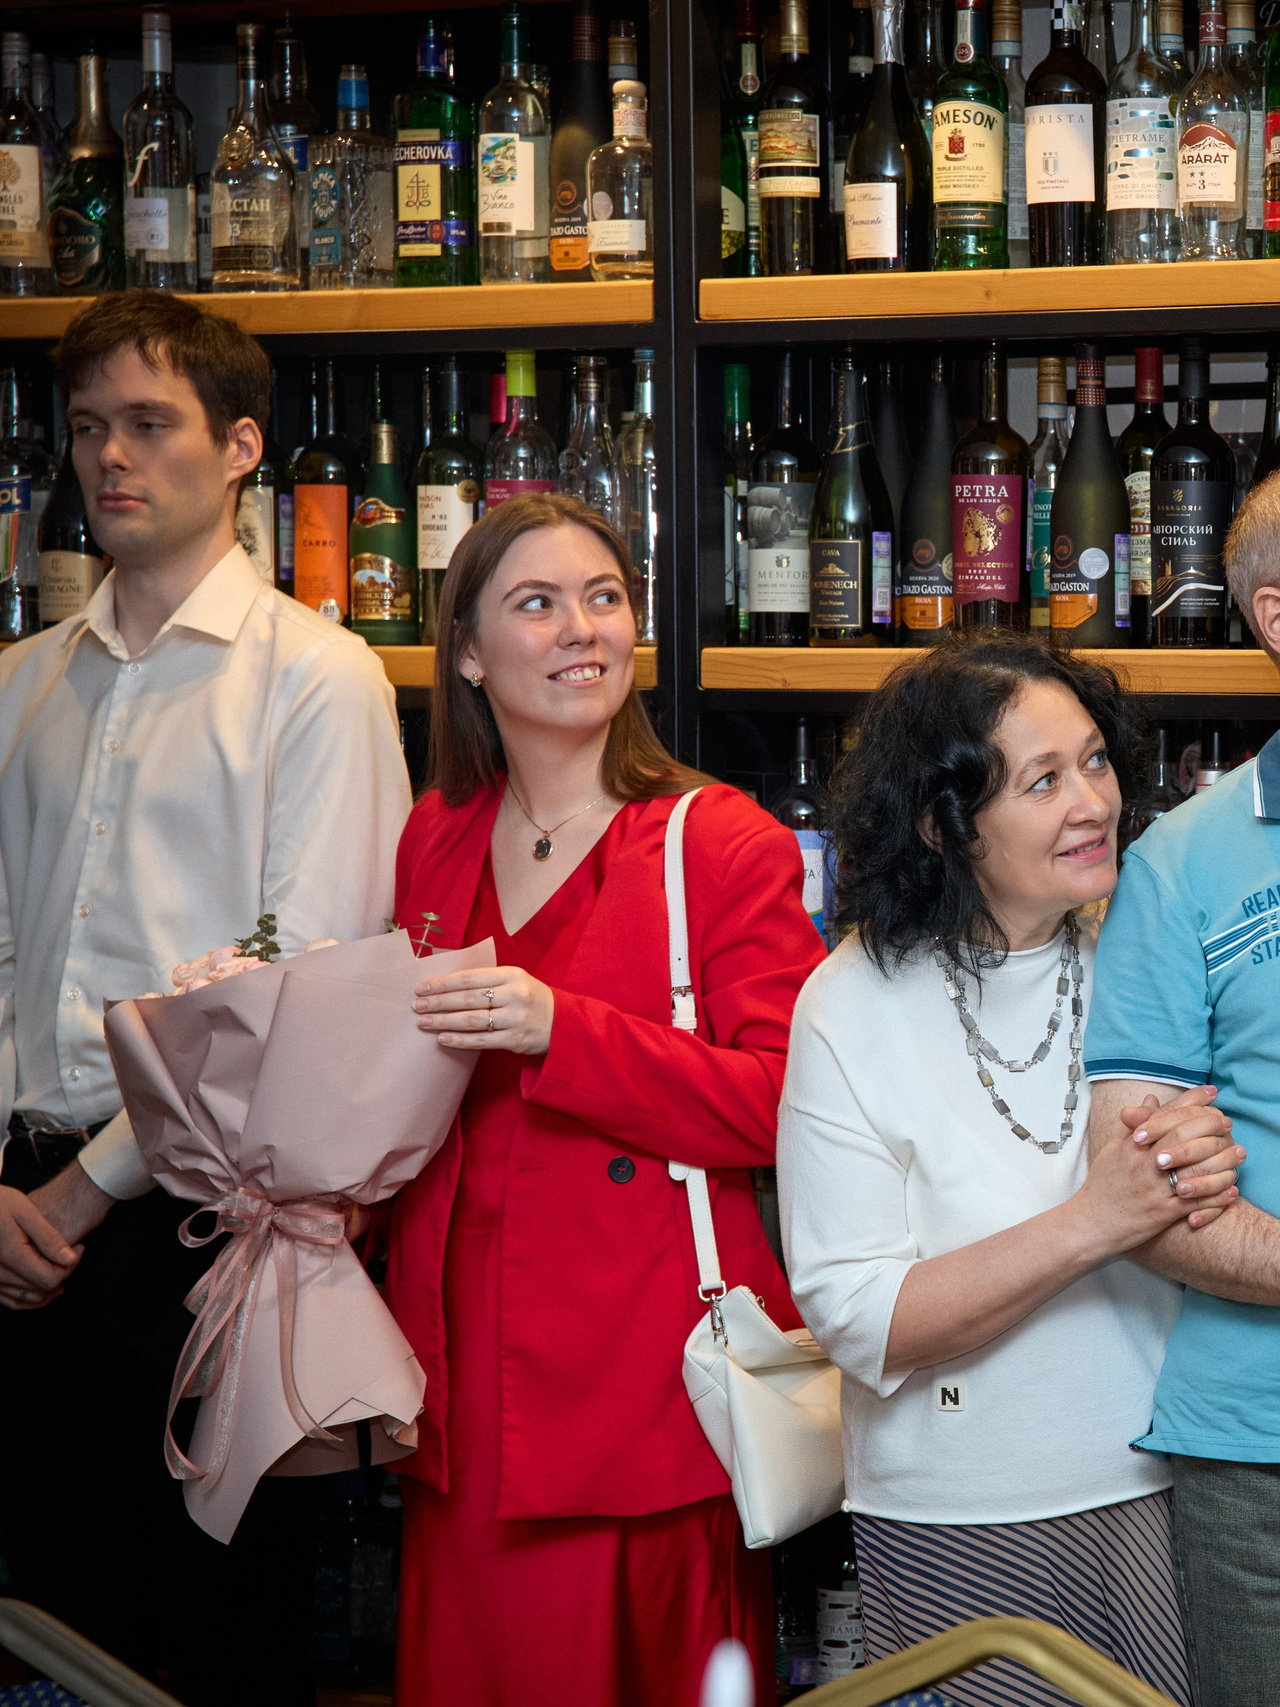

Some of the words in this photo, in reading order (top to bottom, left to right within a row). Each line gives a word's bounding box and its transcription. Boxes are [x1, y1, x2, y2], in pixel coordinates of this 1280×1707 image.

[934, 109, 996, 130] AMESON
[1026, 115, 1085, 125] BARISTA
[1111, 134, 1165, 143] PIETRAME
[1181, 152, 1229, 165] ARARAT
[312, 171, 336, 190] OLMECA
[1198, 180, 1206, 190] 3
[955, 485, 1009, 497] PETRA
[1161, 537, 1197, 546] СТИЛЬ
[758, 571, 808, 579] MENTOR
[921, 584, 953, 594] GASTON
[1060, 582, 1090, 591] GASTON
[323, 605, 335, 614] 88
[803, 869, 815, 879] TA
[941, 1387, 960, 1406] N
[825, 1626, 862, 1635] TRAME
